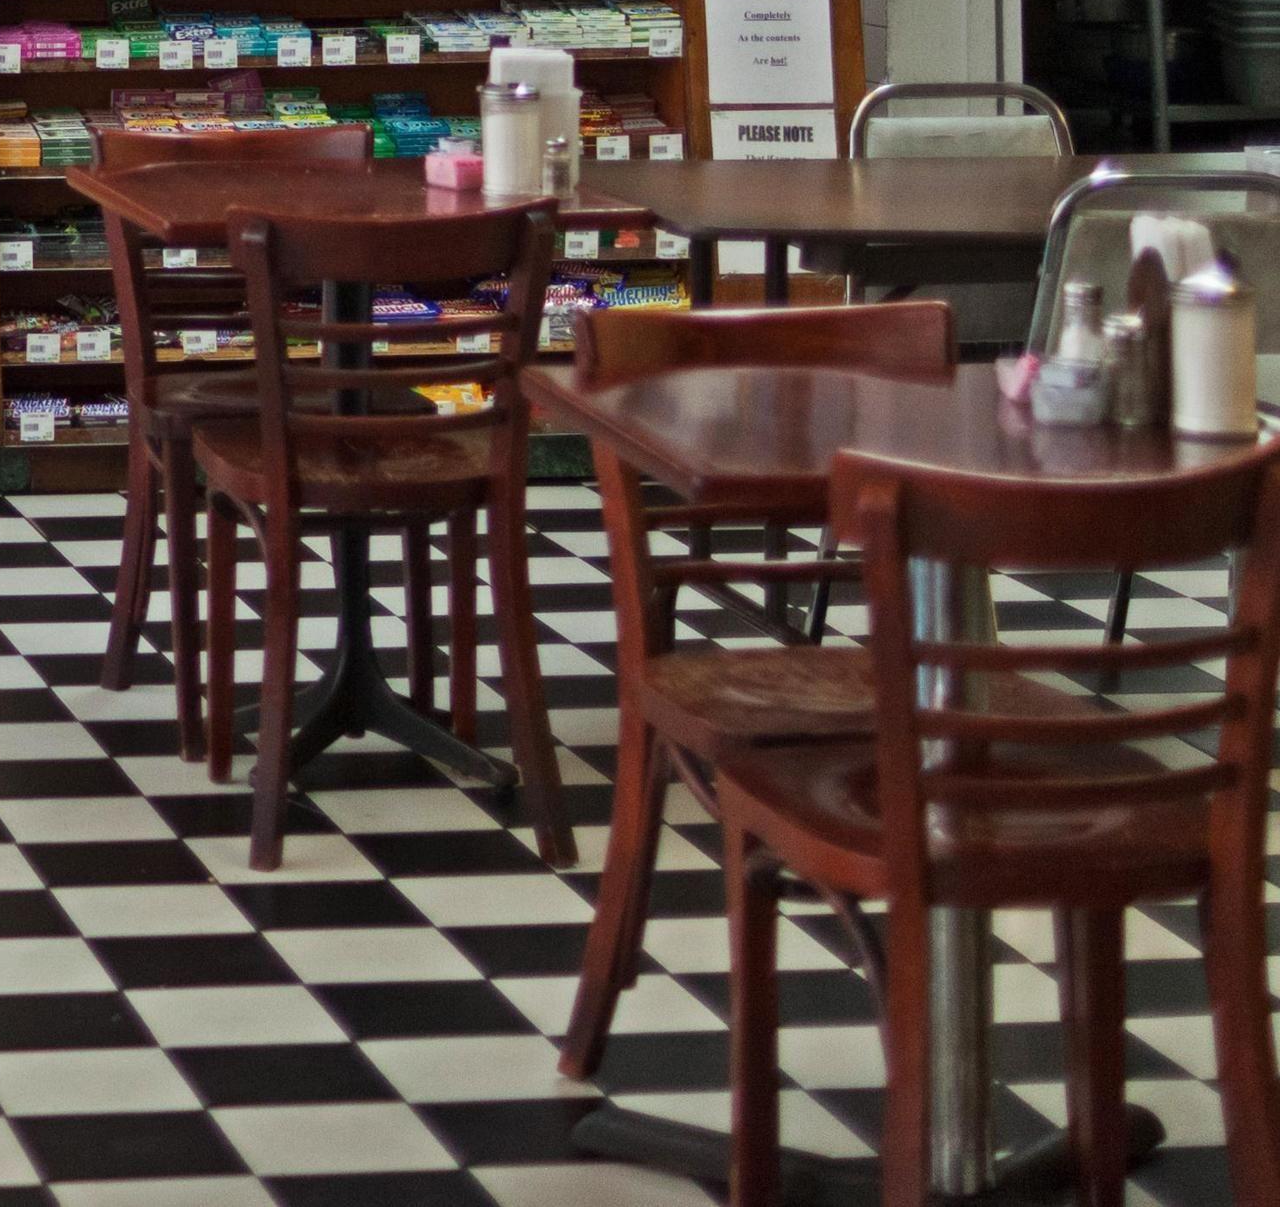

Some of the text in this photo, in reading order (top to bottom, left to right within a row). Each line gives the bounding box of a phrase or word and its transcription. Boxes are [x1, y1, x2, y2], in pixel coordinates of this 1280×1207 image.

[744, 10, 792, 21] Completely
[175, 28, 214, 41] Extra
[738, 34, 801, 42] As the contents
[752, 56, 787, 66] Are hot!
[738, 125, 814, 142] PLEASE NOTE
[12, 406, 70, 418] SNICKERS
[81, 404, 129, 416] SNICKER
